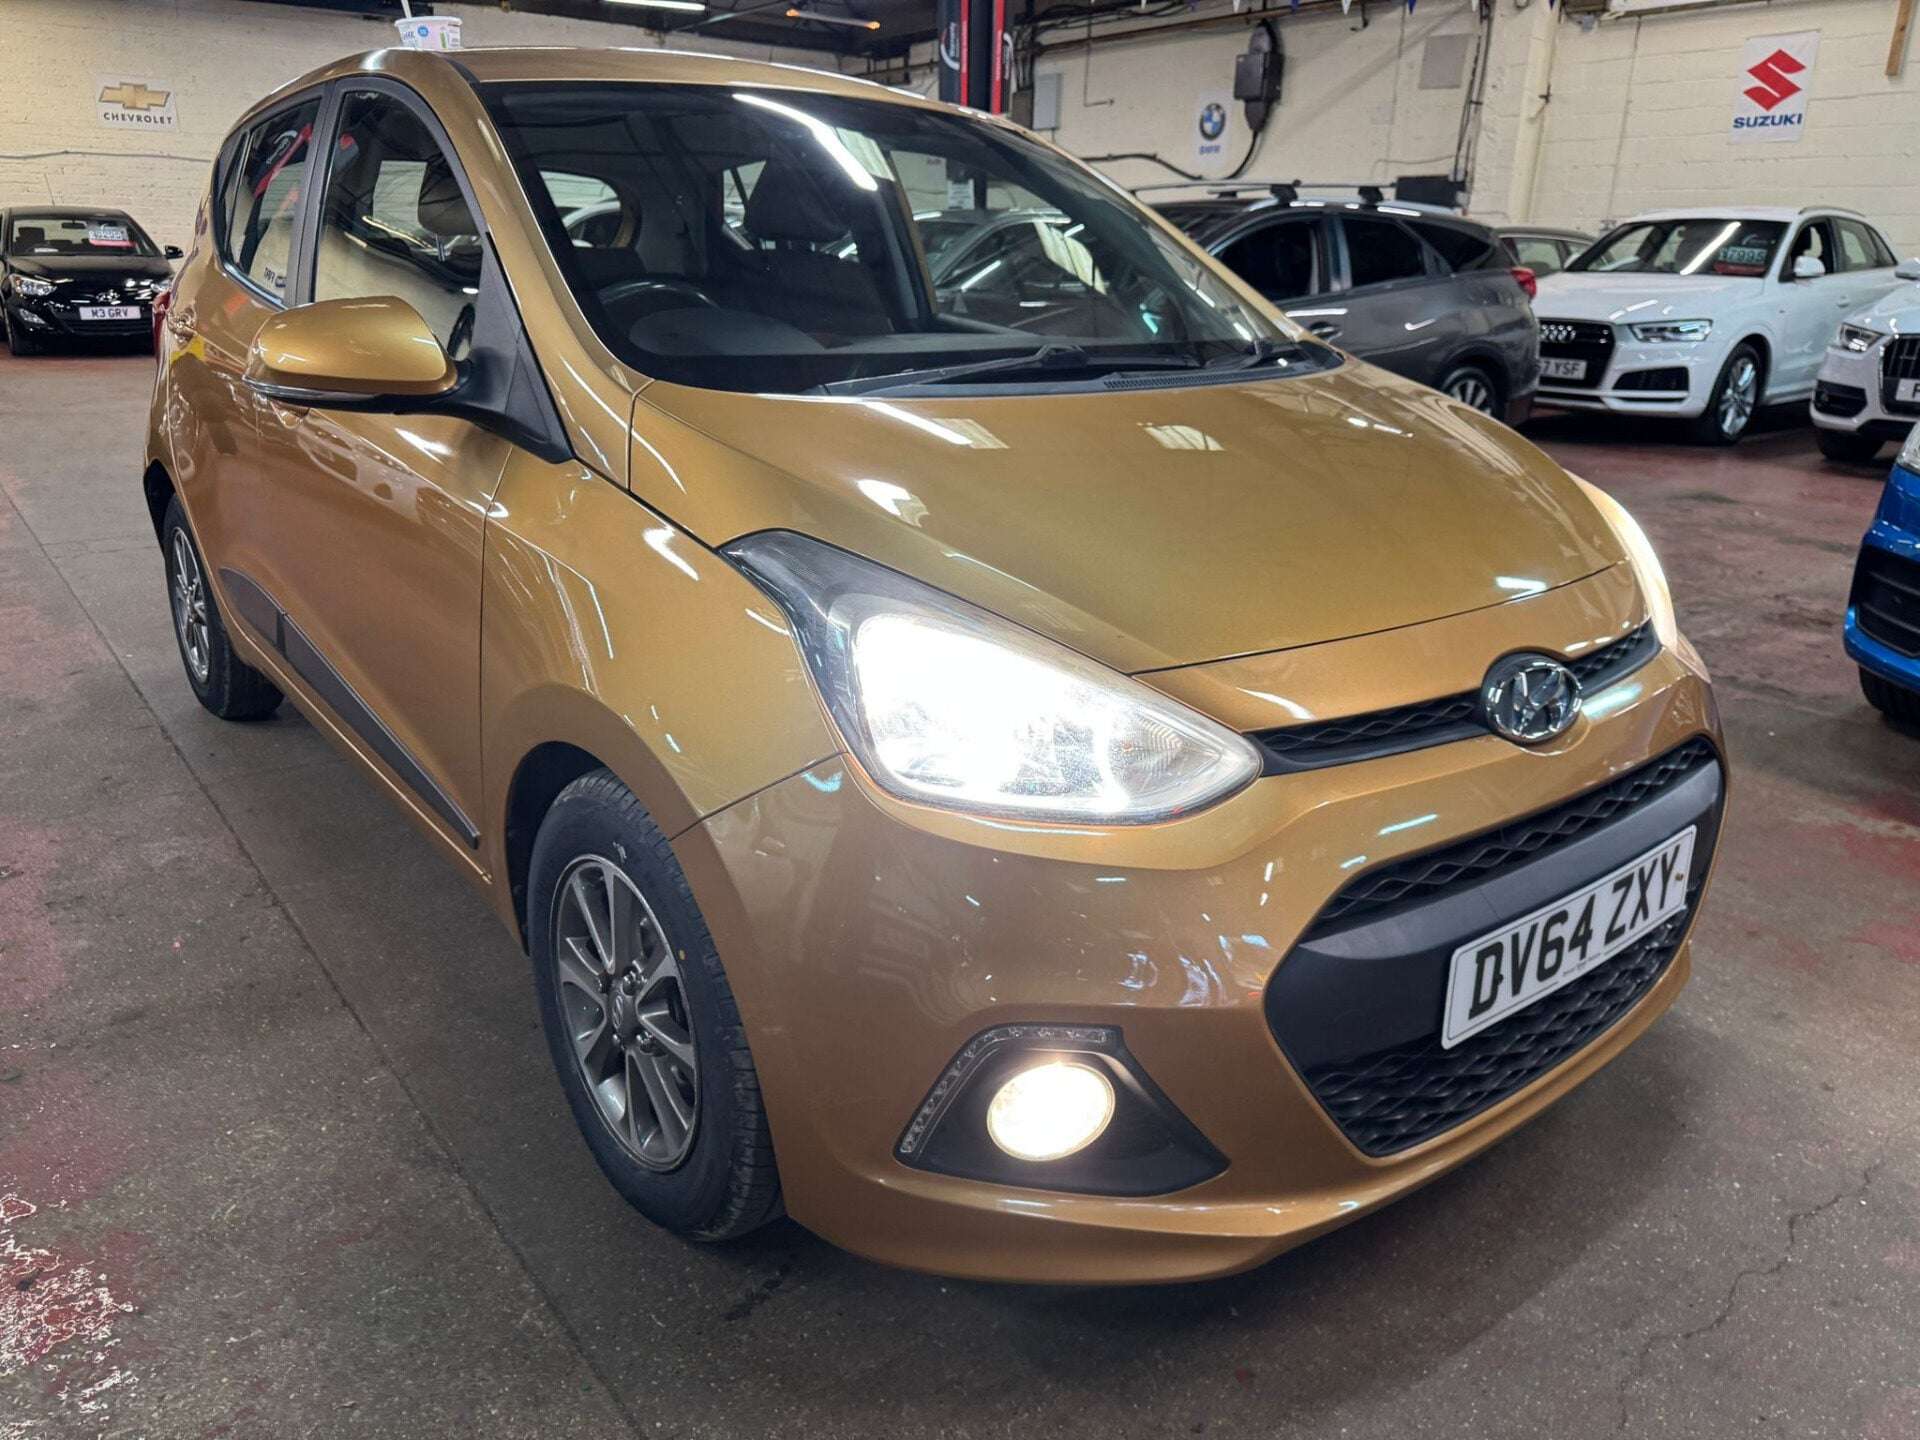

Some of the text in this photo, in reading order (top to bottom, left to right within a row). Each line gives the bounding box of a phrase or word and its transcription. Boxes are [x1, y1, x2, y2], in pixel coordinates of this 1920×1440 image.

[103, 112, 172, 124] CHEVROLET
[1733, 113, 1802, 128] SUZUKI
[1554, 362, 1580, 376] YSF
[1468, 844, 1681, 1020] DV64 ZXY
